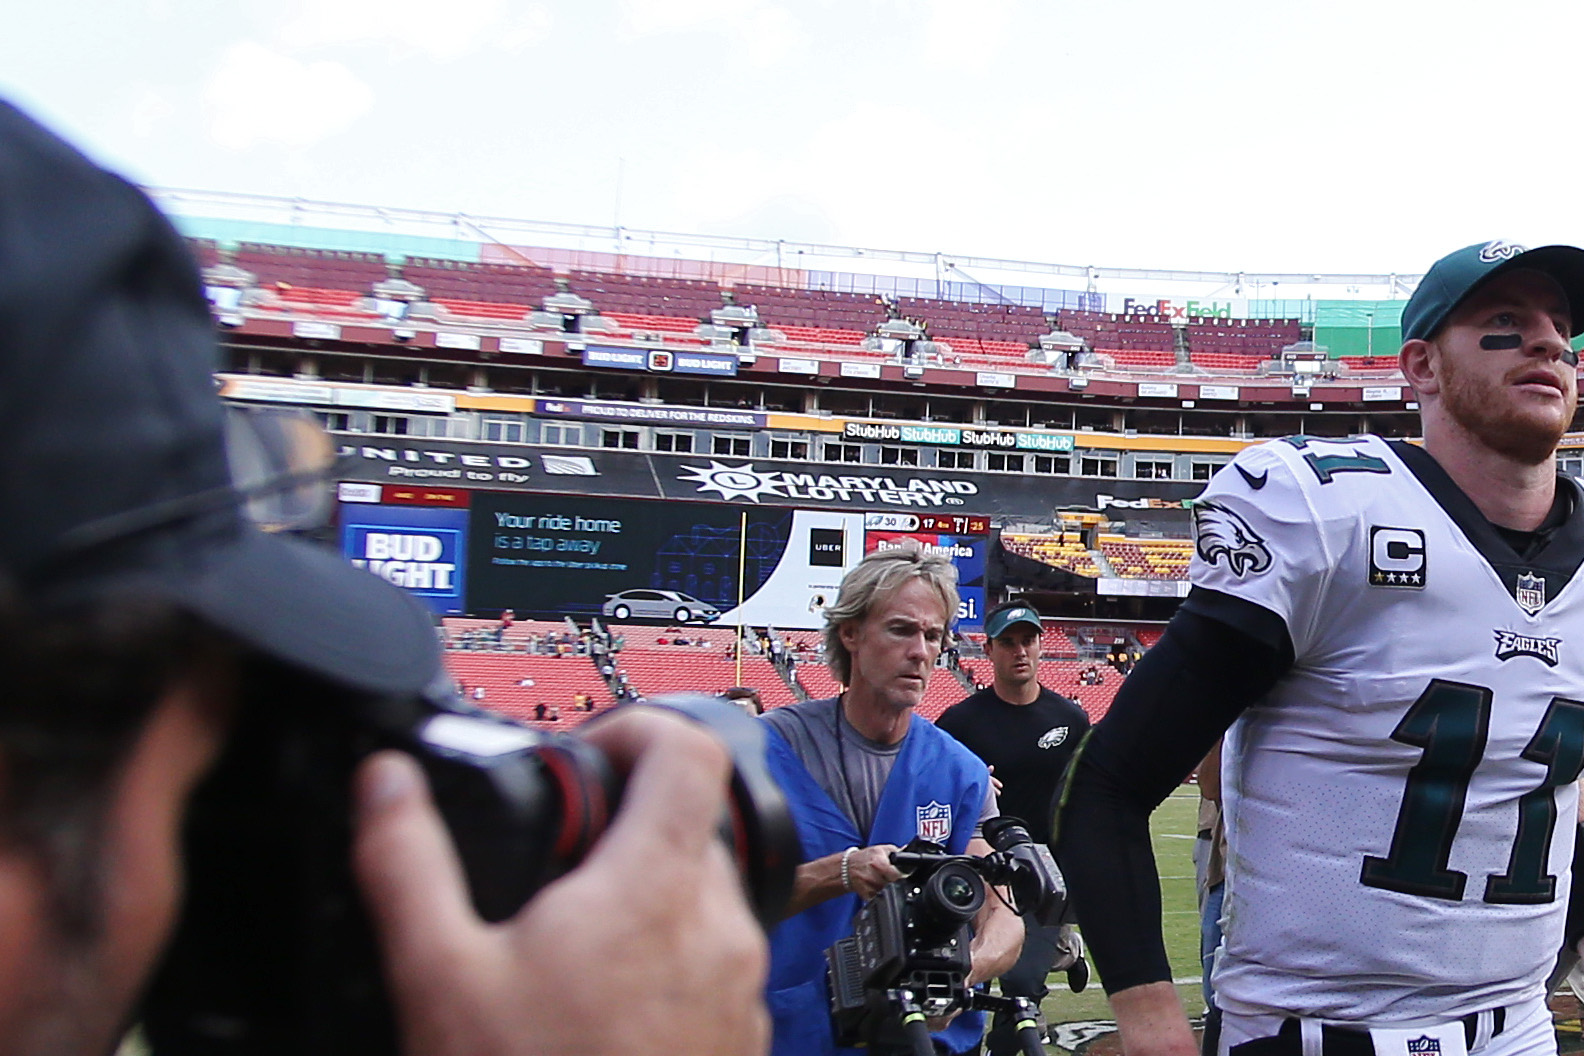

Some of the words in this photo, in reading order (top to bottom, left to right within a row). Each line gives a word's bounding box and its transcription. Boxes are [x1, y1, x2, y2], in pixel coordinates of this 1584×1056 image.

[1123, 298, 1231, 319] FedExField
[588, 351, 610, 361] BUD
[678, 358, 700, 367] BUD
[702, 360, 732, 370] LIGHT
[582, 404, 616, 416] PROUD
[616, 407, 628, 417] TO
[629, 408, 669, 419] DELIVER
[670, 410, 687, 420] FOR
[687, 411, 706, 421] THE
[707, 412, 756, 424] REDSKINS.
[847, 423, 900, 439] StubHub
[902, 427, 956, 443] StubHub
[962, 431, 1015, 447] StubHub
[1019, 436, 1073, 450] StubHub
[389, 467, 461, 479] Proud
[467, 470, 493, 480] to
[498, 469, 529, 483] fly
[779, 472, 978, 496] MARYLAND
[786, 484, 948, 507] LOTTERY
[1097, 494, 1193, 509] FedExF
[494, 512, 536, 529] Your
[538, 514, 572, 530] ride
[575, 516, 622, 533] home
[885, 518, 896, 526] 30
[923, 518, 934, 529] 17
[366, 533, 443, 562] BUD
[494, 533, 509, 549] is
[512, 537, 523, 549] a
[527, 536, 554, 552] tap
[556, 539, 601, 555] away
[815, 543, 842, 552] UBER
[878, 541, 904, 552] Ban
[923, 543, 973, 558] America
[1373, 529, 1424, 572] C
[1521, 590, 1540, 605] NFL
[1500, 631, 1559, 660] EAGLES
[921, 819, 948, 838] NFL
